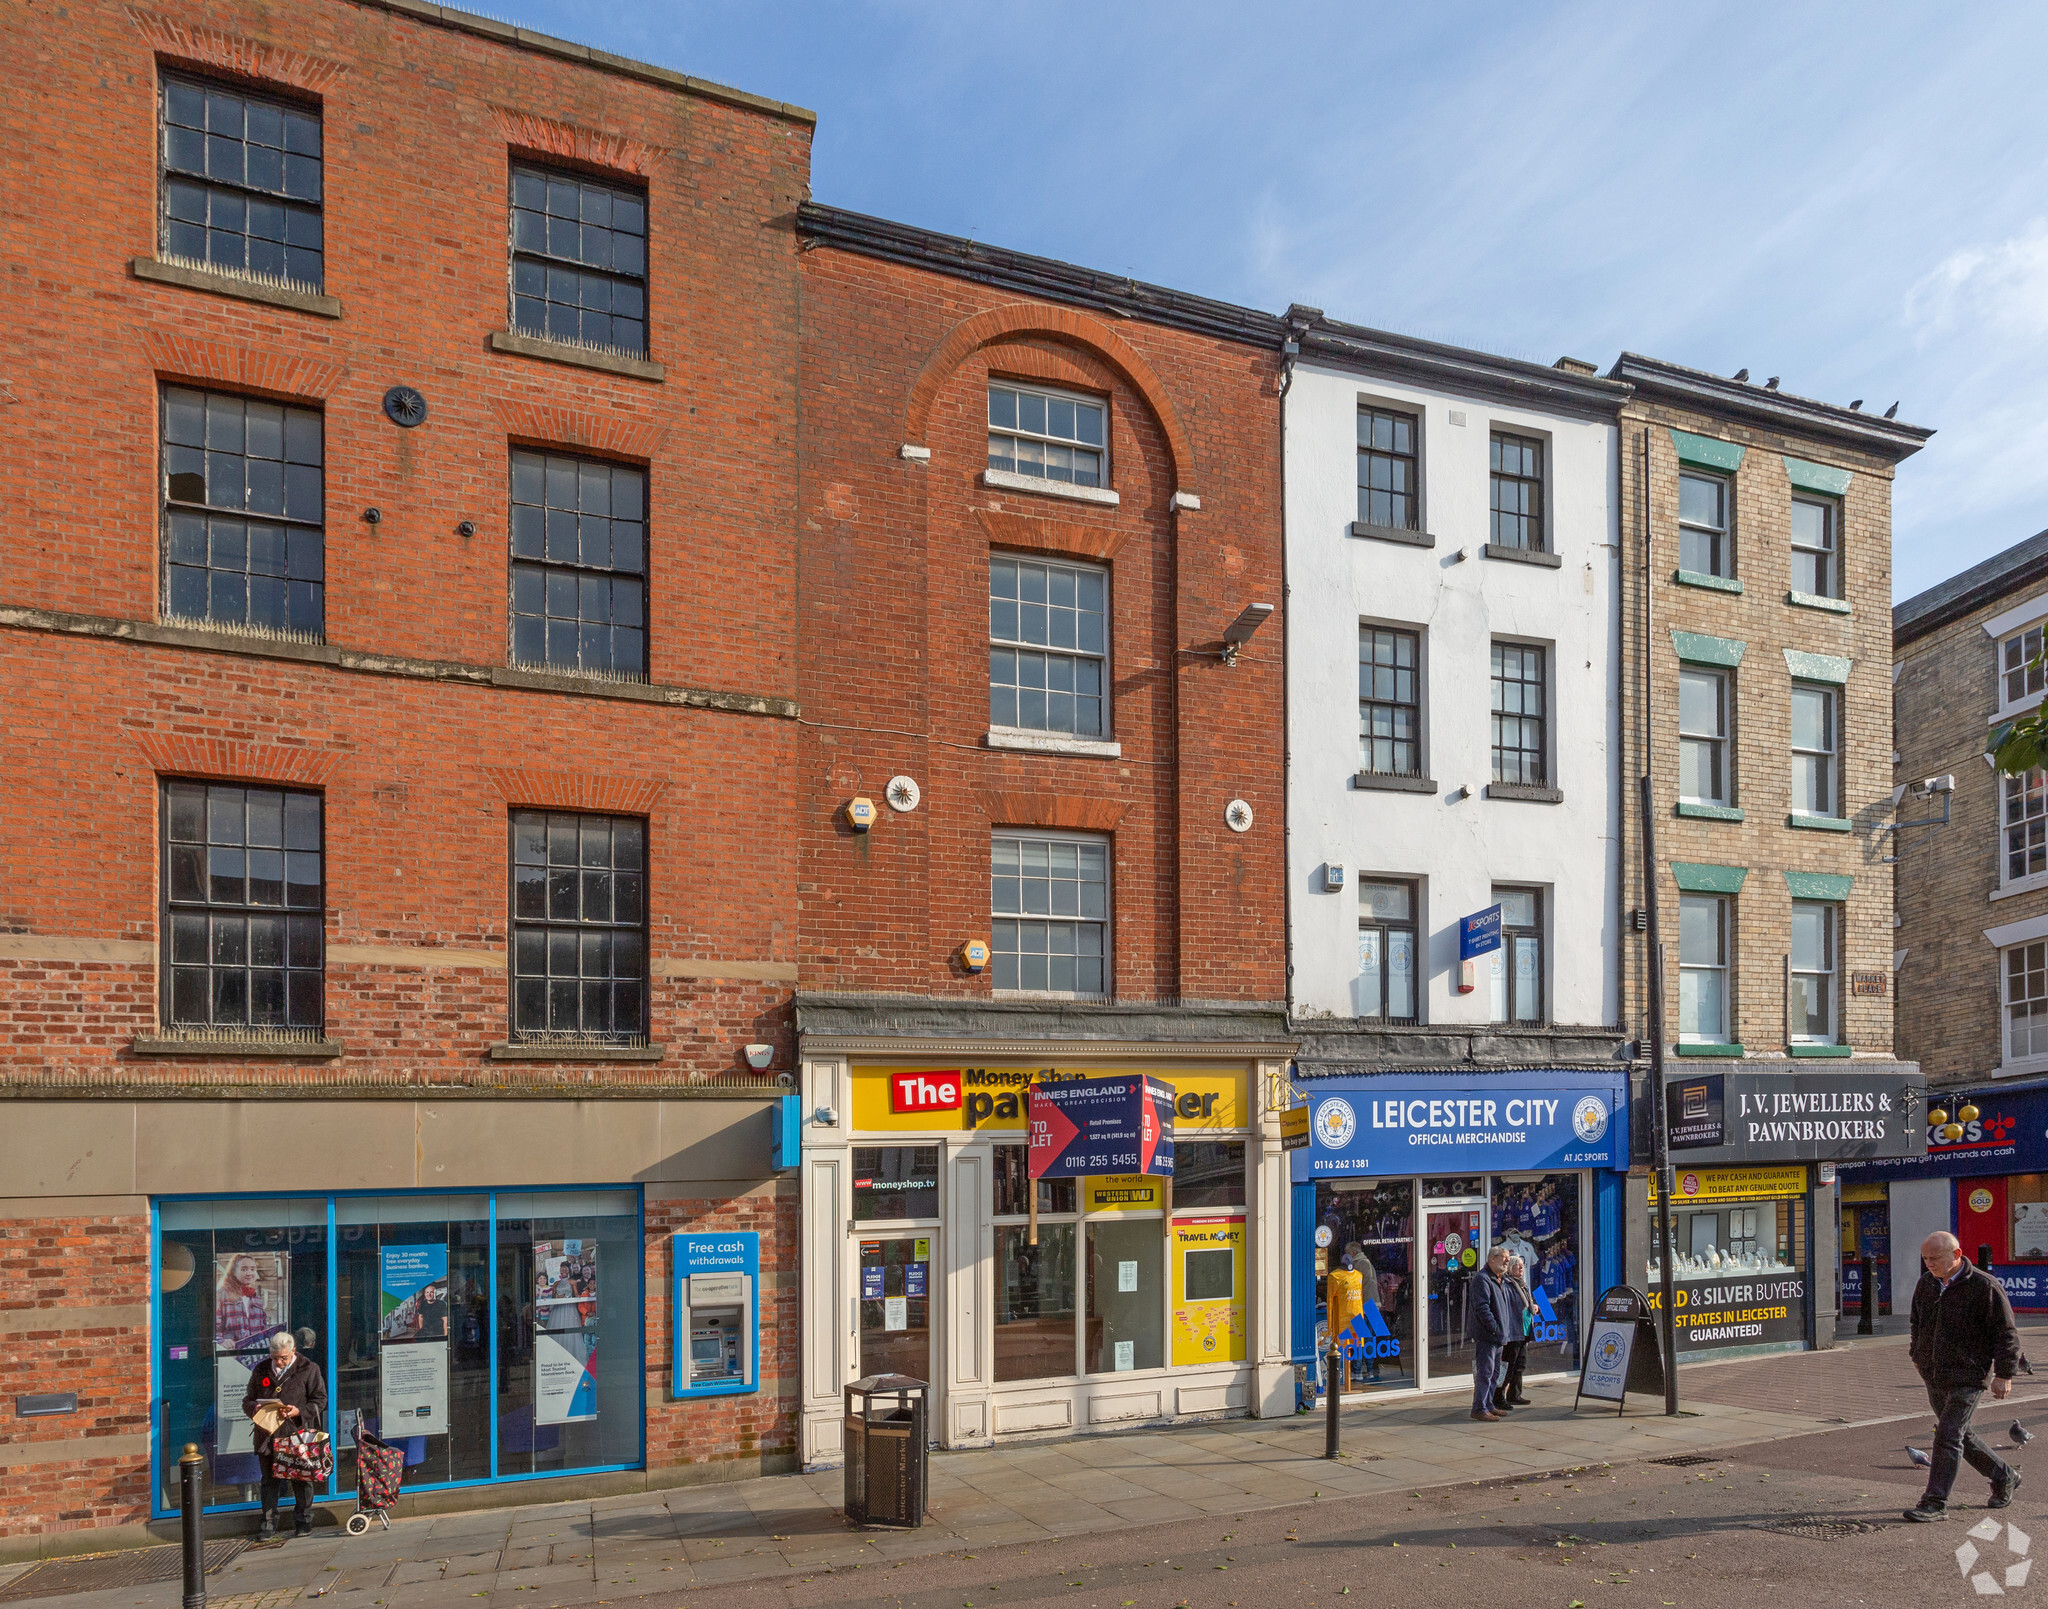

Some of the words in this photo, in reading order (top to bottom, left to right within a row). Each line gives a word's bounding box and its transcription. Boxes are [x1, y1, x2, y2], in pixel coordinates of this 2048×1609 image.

[855, 806, 869, 814] ADT
[971, 949, 983, 957] ADT
[1856, 973, 1885, 983] MARKET
[1859, 984, 1882, 993] PLACE
[967, 1069, 1033, 1088] Money
[899, 1077, 956, 1105] The
[1034, 1090, 1068, 1100] INNES
[1070, 1086, 1126, 1098] ENGLAND
[1740, 1094, 1751, 1118] J.
[1753, 1094, 1769, 1114] V.
[1773, 1092, 1874, 1117] JEWELLERS
[1878, 1092, 1892, 1112] &
[1372, 1099, 1497, 1129] LEICESTER
[1505, 1099, 1559, 1127] CITY
[1144, 1114, 1151, 1127] TO
[1033, 1121, 1047, 1133] TO
[1681, 1123, 1716, 1134] JEWELLERS
[1748, 1120, 1886, 1142] PAWNBROKERS
[1033, 1134, 1053, 1147] LET
[1144, 1128, 1152, 1142] LET
[1409, 1133, 1454, 1146] OFFICIAL
[1455, 1132, 1526, 1145] MERCHANDISE
[1672, 1131, 1720, 1143] PAWNBROKERS
[1065, 1156, 1086, 1168] 0116
[1090, 1155, 1108, 1167] 255
[1112, 1153, 1137, 1165] 5455
[1564, 1153, 1573, 1162] AT
[1574, 1153, 1583, 1162] JC
[1584, 1152, 1609, 1161] SPORTS
[1902, 1156, 1917, 1164] you
[1918, 1154, 1933, 1164] get
[1933, 1153, 1951, 1163] your
[1953, 1149, 1979, 1159] hands
[1994, 1147, 2015, 1156] cash
[1314, 1160, 1334, 1169] 0116
[1335, 1160, 1350, 1169] 262
[1352, 1159, 1369, 1168] 1381
[1121, 1175, 1143, 1183] world
[1706, 1174, 1716, 1182] WE
[1717, 1173, 1729, 1181] PAY
[1730, 1172, 1747, 1181] CASH
[1748, 1171, 1762, 1180] AND
[1763, 1170, 1800, 1179] GUARANTEE
[872, 1179, 936, 1190] moneyshop.tv
[1708, 1186, 1718, 1194] TO
[1719, 1185, 1734, 1193] BEAT
[1735, 1184, 1749, 1192] ANY
[1750, 1183, 1777, 1191] GENUINE
[1778, 1182, 1800, 1191] QUOTE
[1179, 1233, 1208, 1242] TRAVEL
[688, 1242, 714, 1254] Free
[717, 1240, 744, 1253] cash
[397, 1257, 421, 1265] everyday
[689, 1255, 744, 1266] withdrawals
[1648, 1290, 1688, 1310] GOD
[1691, 1288, 1701, 1307] &
[1704, 1284, 1753, 1305] SILVER
[1756, 1280, 1804, 1301] BUYERS
[1690, 1312, 1722, 1327] RATES
[1723, 1310, 1735, 1323] IN
[1736, 1306, 1787, 1322] LEICESTER
[1689, 1323, 1762, 1342] GUARANTEED!
[1597, 1376, 1621, 1385] SPORTS
[899, 1437, 907, 1471] Market
